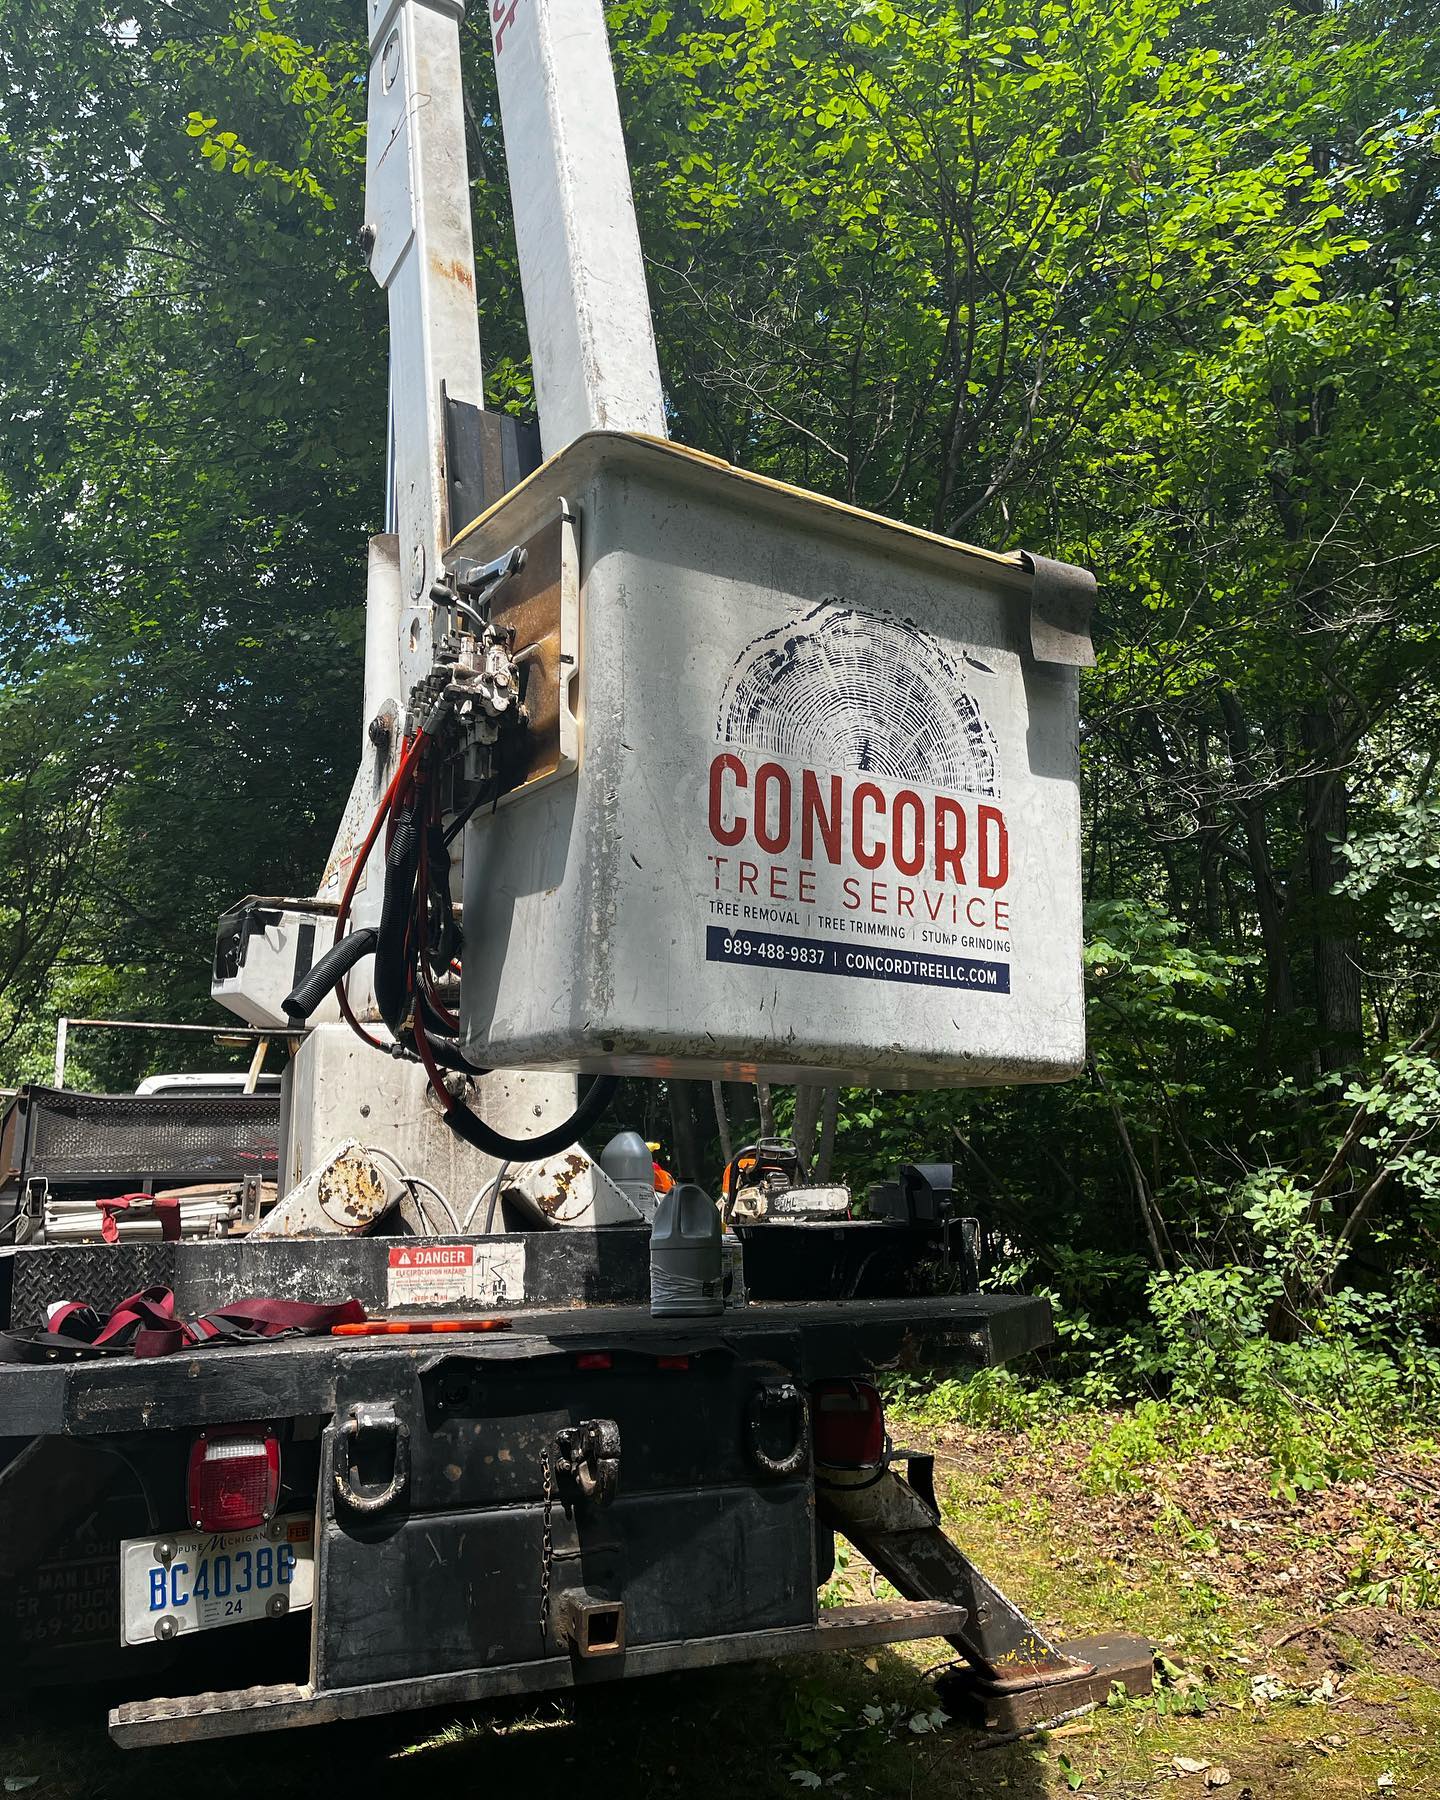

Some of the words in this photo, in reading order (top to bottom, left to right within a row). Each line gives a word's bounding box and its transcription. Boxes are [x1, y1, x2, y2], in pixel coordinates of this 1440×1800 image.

[708, 752, 1010, 890] CONCORD
[707, 855, 816, 904] TREE
[842, 877, 1009, 931] SERVICE
[709, 900, 739, 916] TREE
[743, 905, 800, 925] REMOVAL
[817, 916, 846, 931] TREE
[850, 920, 905, 939] TRIMMING
[922, 930, 957, 945] STUMP
[961, 935, 1010, 953] GRINDING
[724, 938, 825, 965] 989-488-9837
[846, 953, 997, 985] CONCORDTREELLC.COM
[396, 1269, 442, 1277] ELECTROCUTION
[416, 1250, 465, 1264] DANGER
[178, 1544, 203, 1555] PURE
[201, 1533, 266, 1556] MICHIGAN
[289, 1526, 310, 1539] FEB
[149, 1543, 294, 1612] BC40388
[224, 1599, 243, 1616] 24
